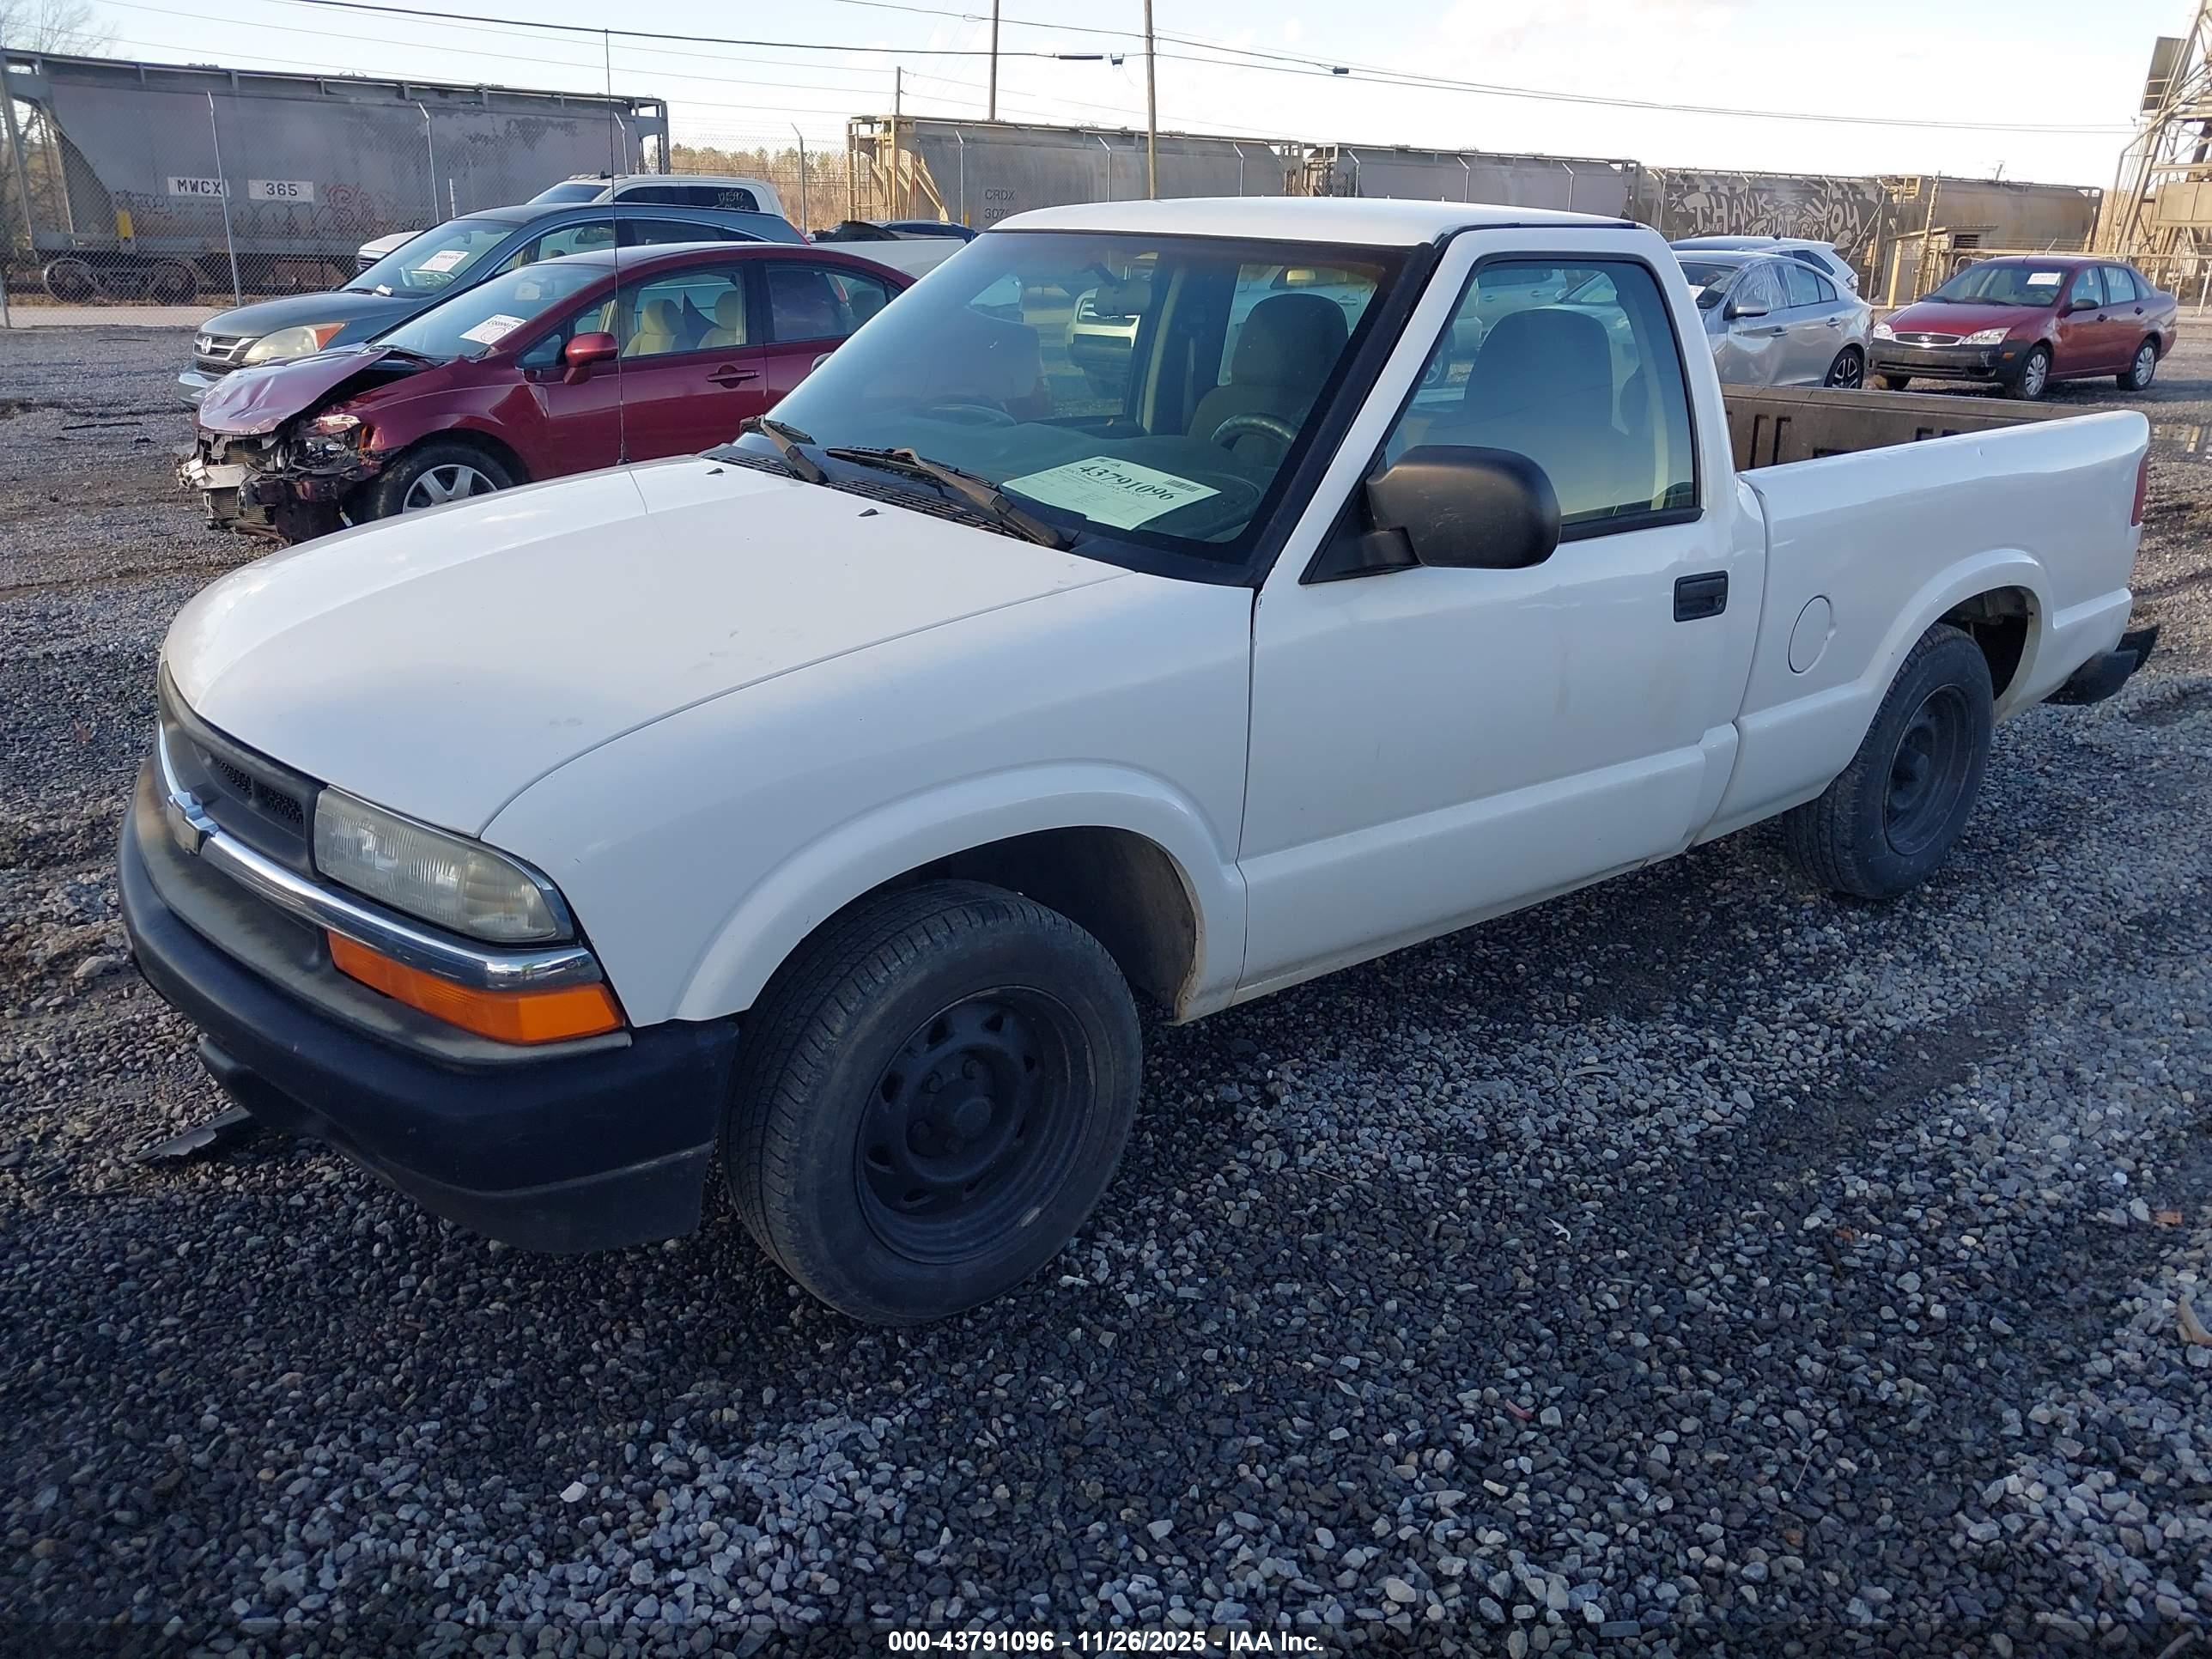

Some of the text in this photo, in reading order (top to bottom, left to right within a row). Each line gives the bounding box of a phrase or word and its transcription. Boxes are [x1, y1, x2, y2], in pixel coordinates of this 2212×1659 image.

[177, 179, 299, 197] MWCX 365
[1682, 191, 1774, 235] THANK
[1805, 197, 1862, 234] YOU
[1079, 465, 1183, 500] 43791096
